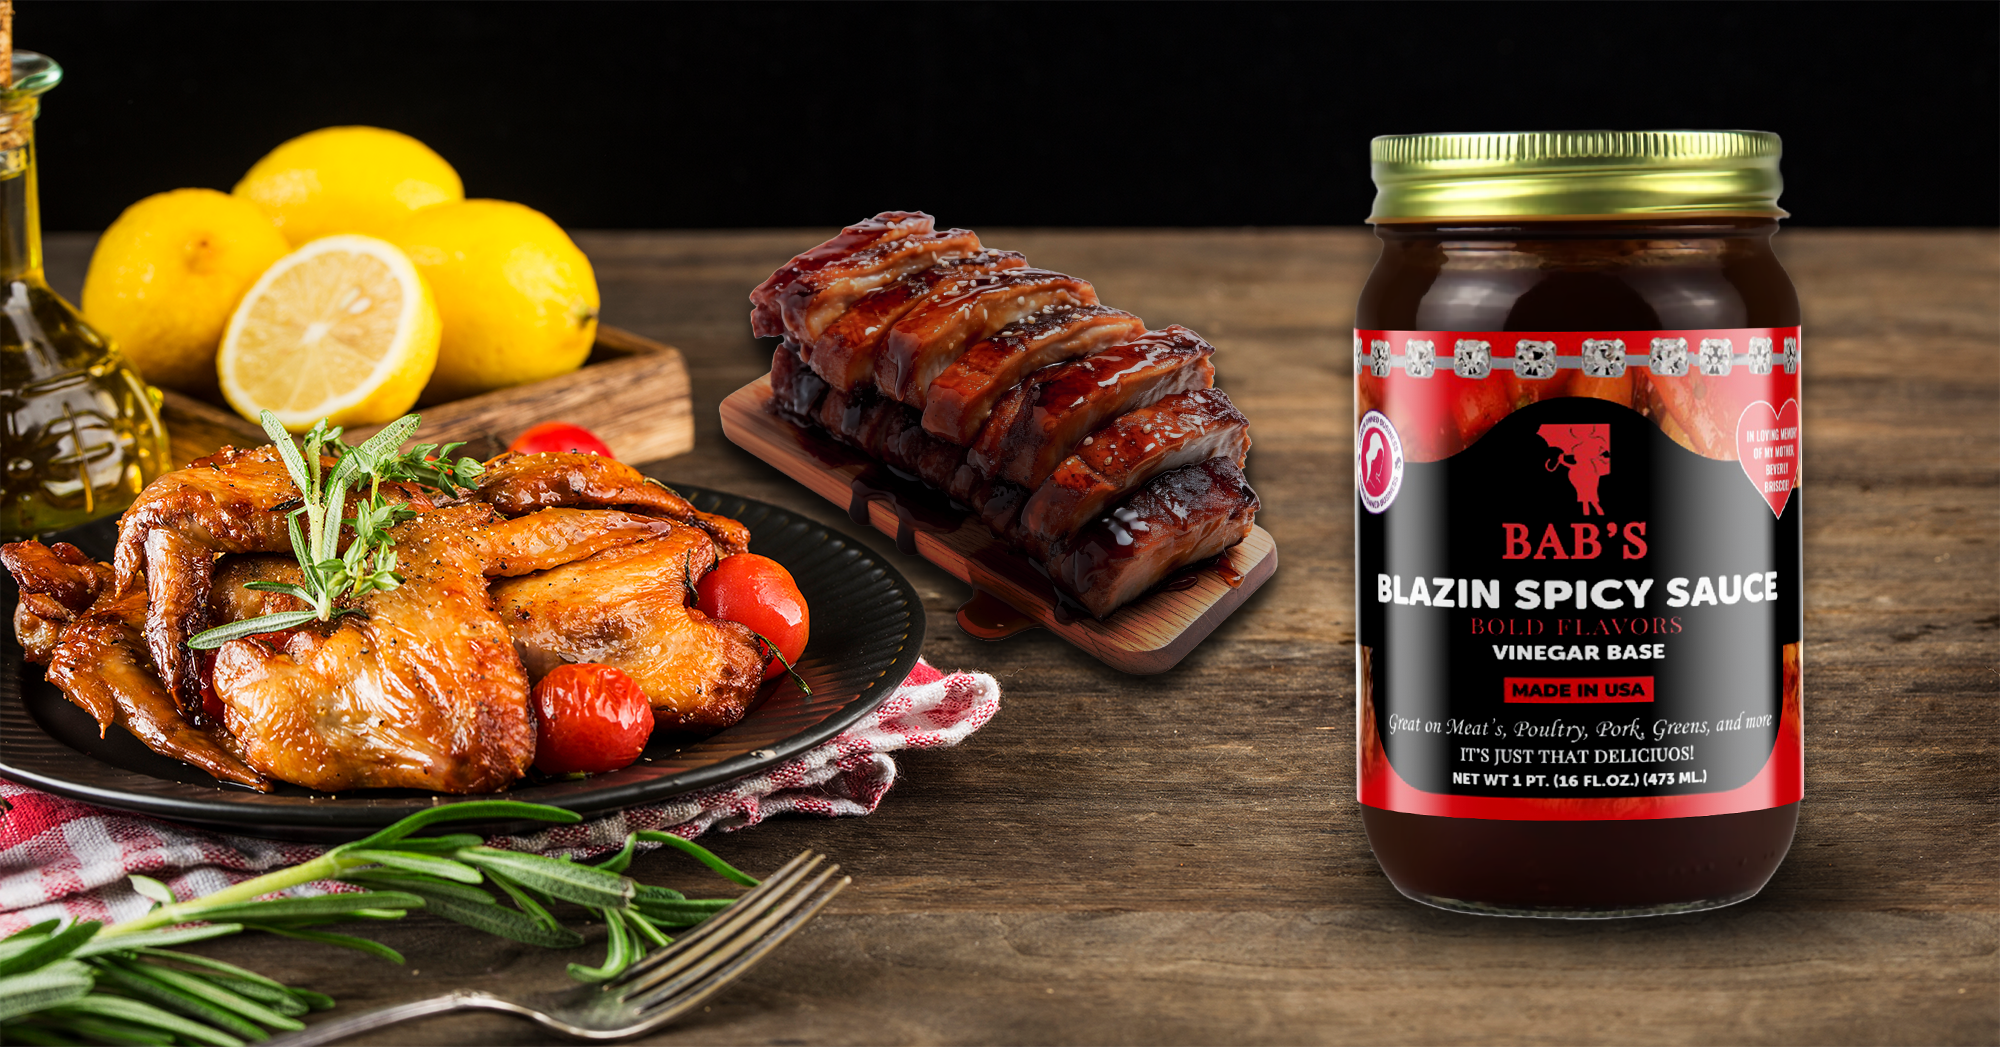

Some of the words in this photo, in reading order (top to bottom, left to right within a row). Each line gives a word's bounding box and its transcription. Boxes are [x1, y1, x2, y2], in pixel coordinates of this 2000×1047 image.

[1380, 419, 1398, 452] BUSINESS
[1747, 430, 1754, 442] IN
[1757, 429, 1779, 442] LOVING
[1754, 448, 1762, 459] OF
[1765, 447, 1773, 458] MY
[1775, 444, 1794, 457] MOTHER,
[1766, 462, 1788, 475] BEVERLY
[1380, 476, 1398, 507] BUSINESS
[1502, 522, 1648, 560] BAB’S
[1378, 573, 1500, 608] BLAZIN
[1515, 578, 1654, 610] SPICY
[1666, 571, 1778, 607] SAUCE
[1471, 617, 1543, 635] BOLD
[1558, 616, 1682, 635] FLAVORS
[1492, 645, 1599, 660] VINEGAR
[1607, 644, 1665, 660] BASE
[1512, 684, 1571, 698] MADE
[1578, 684, 1598, 697] IN
[1605, 683, 1645, 697] USA
[1389, 714, 1421, 735] Great
[1425, 720, 1442, 733] on
[1513, 720, 1589, 742] Poultry,
[1596, 718, 1645, 739] Pork,
[1653, 719, 1710, 741] Greens,
[1716, 712, 1744, 731] and
[1745, 713, 1772, 729] more
[1460, 748, 1489, 762] IT’S
[1494, 749, 1533, 765] JUST
[1539, 750, 1589, 764] THAT
[1594, 745, 1694, 763] DELICIUOS!
[1453, 772, 1480, 785] NET
[1484, 773, 1509, 786] WT
[1512, 774, 1521, 787] 1
[1526, 774, 1549, 787] PT.
[1553, 774, 1579, 788] (16
[1584, 773, 1639, 788] FL.OZ.)
[1643, 772, 1675, 787] (473
[1679, 769, 1707, 784] ML.)
